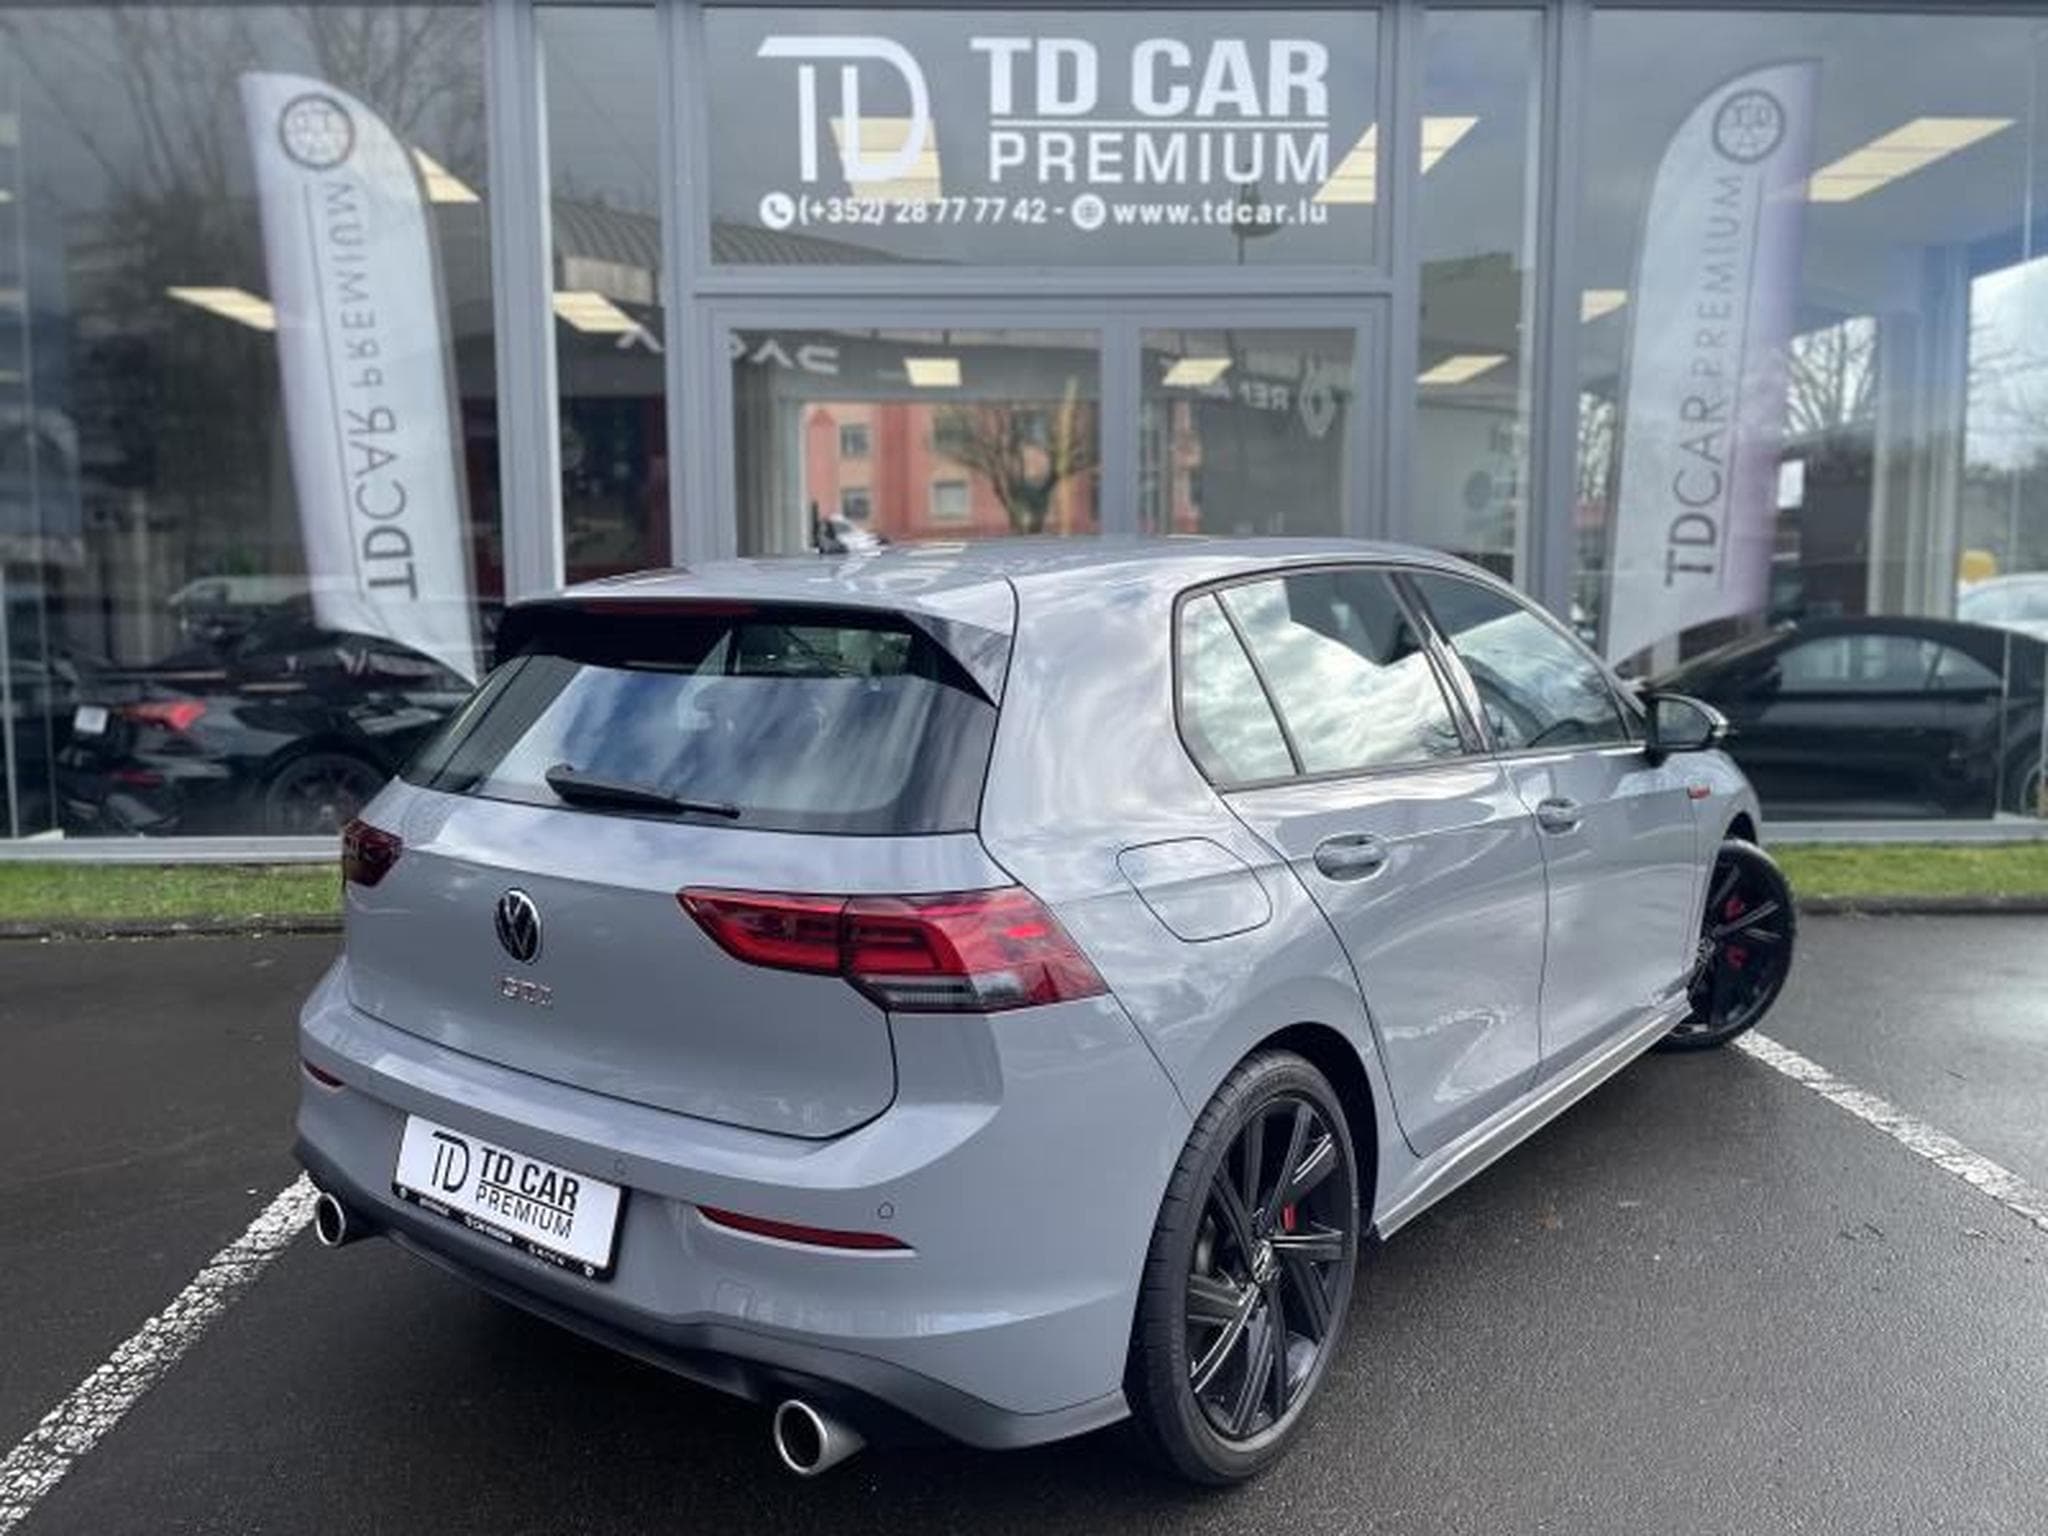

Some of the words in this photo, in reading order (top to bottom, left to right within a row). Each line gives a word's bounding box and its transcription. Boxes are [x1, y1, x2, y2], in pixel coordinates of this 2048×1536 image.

[970, 37, 1098, 116] TD
[1130, 38, 1329, 117] CAR
[989, 132, 1329, 184] PREMIUM
[800, 194, 886, 226] (+352)
[894, 197, 929, 224] 28
[1012, 197, 1047, 224] 42
[1112, 199, 1328, 225] www.tdcar.lu
[1691, 174, 1743, 379] PREMIUM
[480, 1146, 514, 1186] TD
[520, 1163, 580, 1212] CAR
[475, 1184, 574, 1240] PREMIUM
